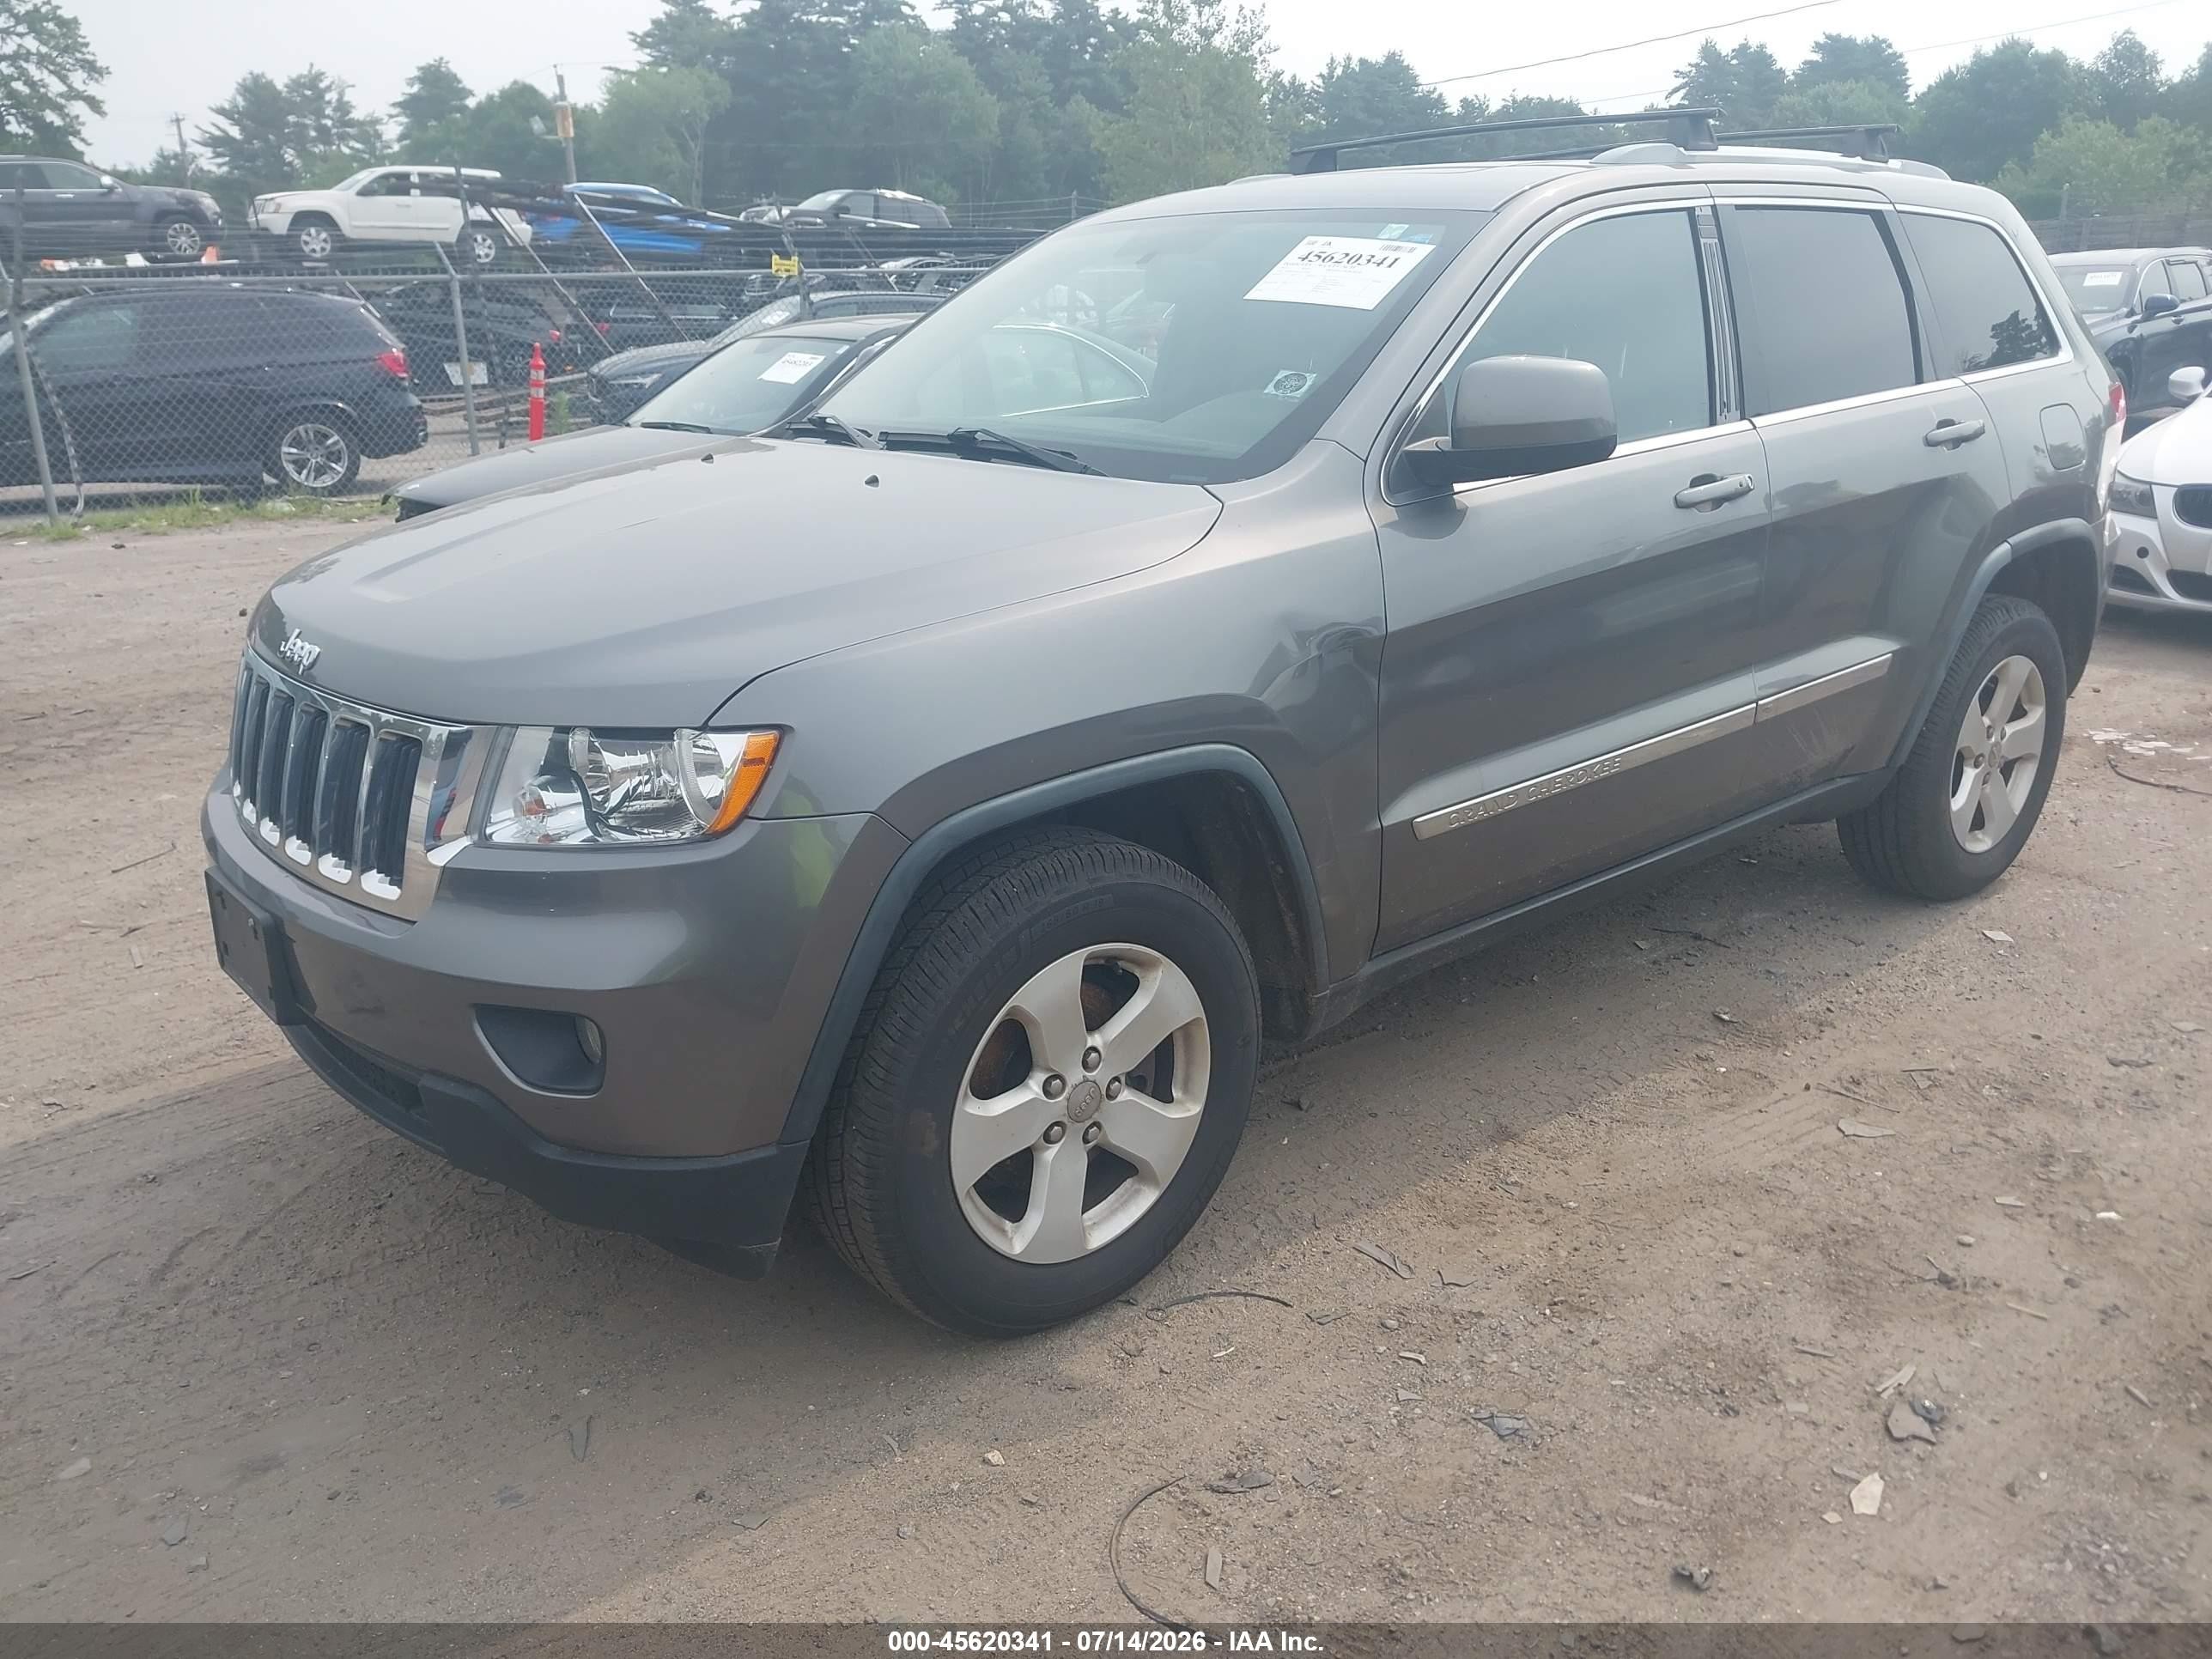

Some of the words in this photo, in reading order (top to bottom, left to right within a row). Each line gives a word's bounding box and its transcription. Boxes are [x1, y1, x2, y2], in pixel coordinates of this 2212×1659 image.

[1297, 251, 1401, 269] 45620341
[276, 628, 320, 675] Jeep
[1449, 792, 1518, 828] GRAND
[1528, 757, 1622, 802] CHEROKEE
[1074, 1087, 1097, 1118] Jeep
